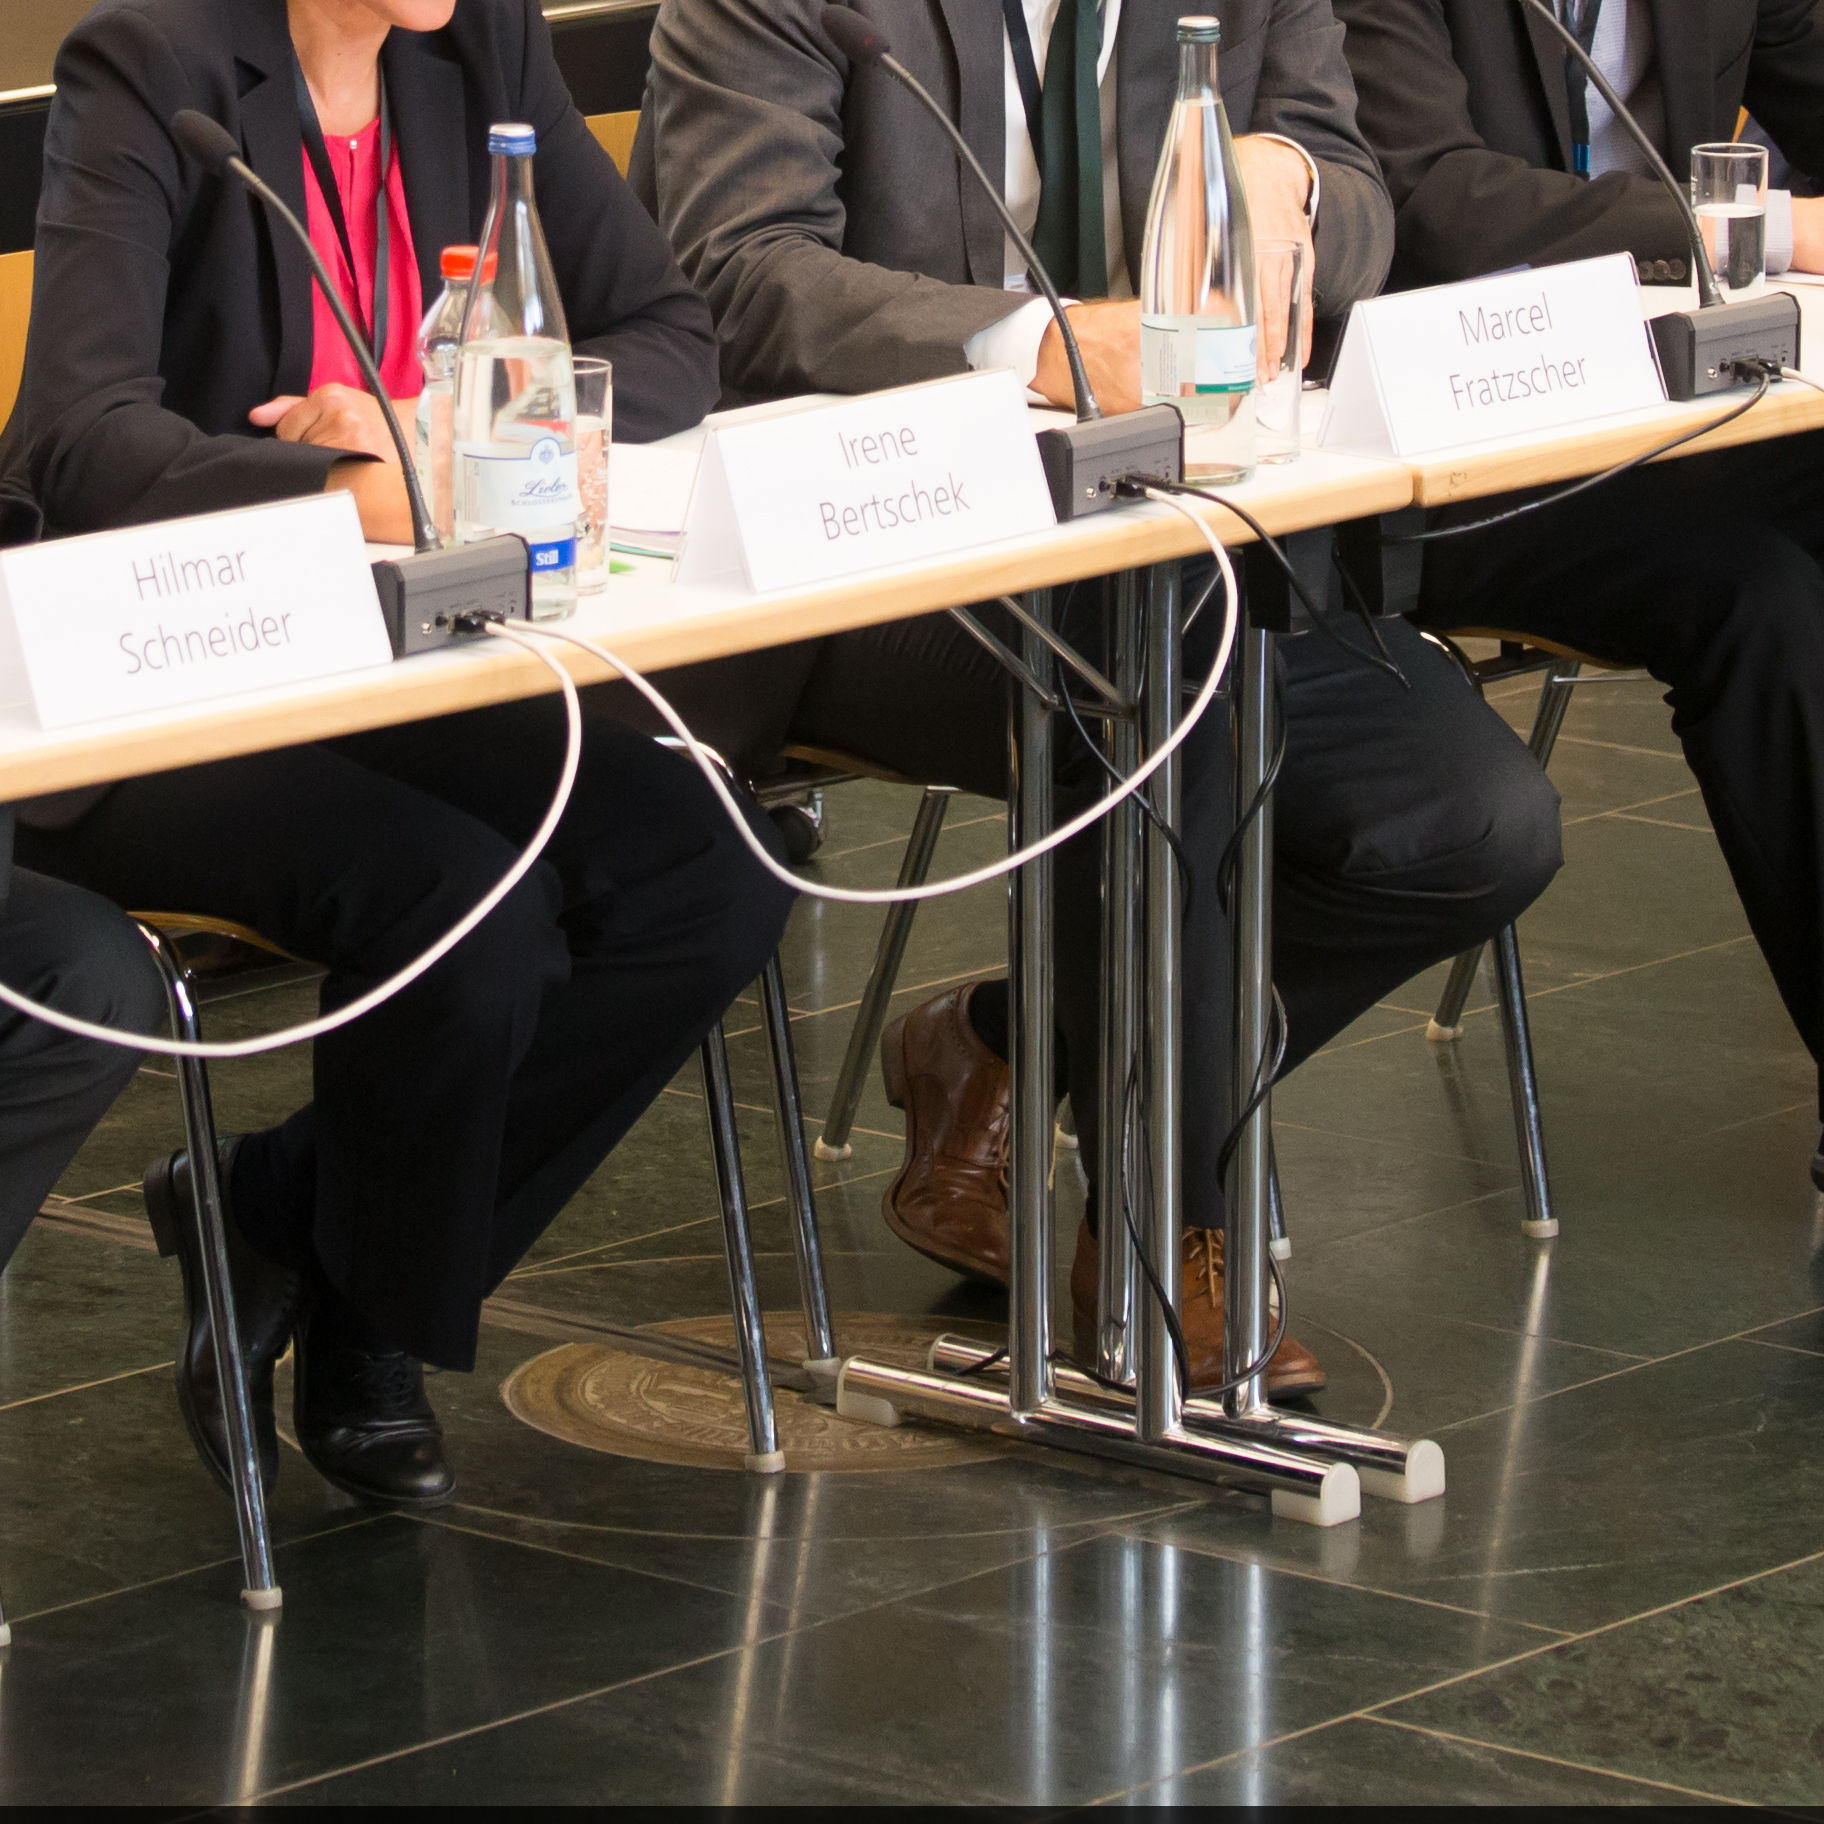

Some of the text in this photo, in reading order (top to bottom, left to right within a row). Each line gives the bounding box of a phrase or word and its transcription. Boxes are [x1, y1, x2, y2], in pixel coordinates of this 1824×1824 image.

[1458, 292, 1552, 345] Marcel
[1449, 355, 1585, 410] Fratzscher
[838, 427, 918, 468] Irene
[819, 473, 970, 541] Bertschek
[132, 551, 245, 600] Hilmar
[535, 549, 559, 566] Still
[119, 607, 291, 675] Schneider
